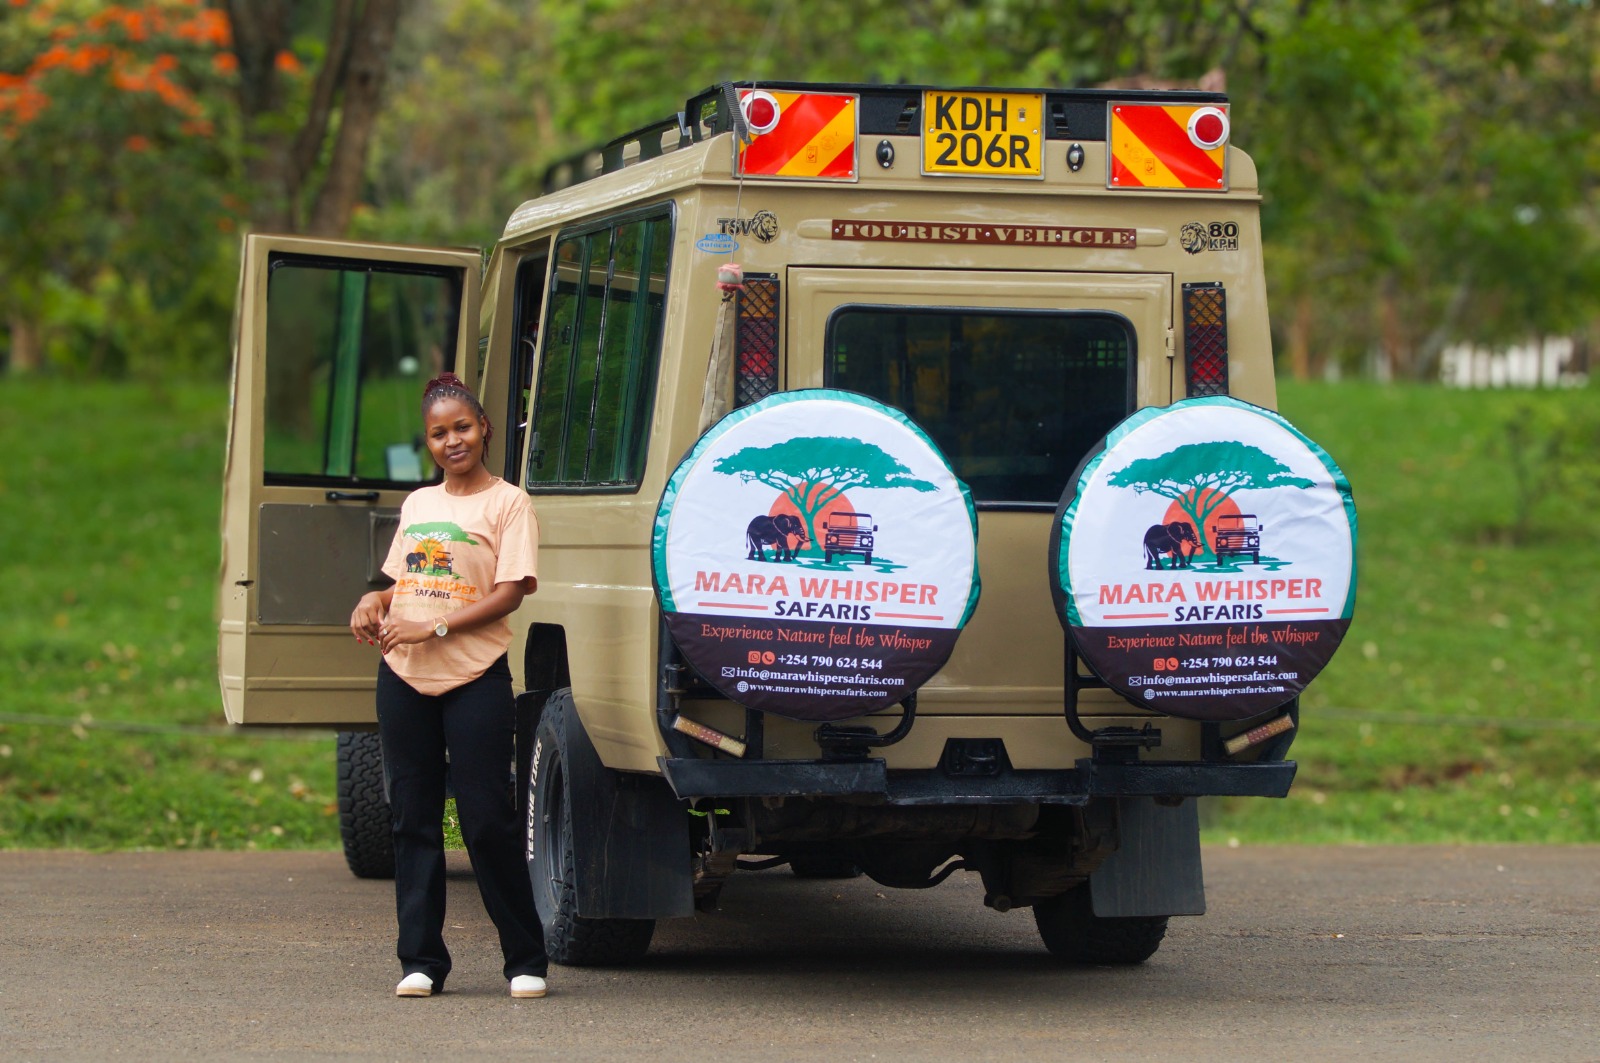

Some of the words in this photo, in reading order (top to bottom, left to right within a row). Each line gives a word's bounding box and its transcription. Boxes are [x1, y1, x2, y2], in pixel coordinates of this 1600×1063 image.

[935, 95, 1008, 132] KDH
[935, 132, 1031, 168] 206R
[718, 218, 753, 236] TSV
[839, 223, 982, 241] TOURIST
[993, 227, 1130, 244] VEHICLE
[1209, 223, 1238, 237] 80
[1209, 238, 1238, 249] KPH
[415, 589, 451, 599] SAFARIS
[423, 579, 477, 595] WHISPER
[694, 571, 790, 597] MARA
[801, 577, 939, 605] WHISPER
[1099, 582, 1187, 605] MARA
[1195, 578, 1323, 601] WHISPER
[774, 600, 871, 620] SAFARIS
[1174, 604, 1263, 622] SAFARIS
[701, 623, 773, 642] Experience
[777, 628, 825, 644] Nature
[828, 626, 853, 648] feel
[855, 628, 875, 648] the
[879, 630, 932, 653] Whisper
[1107, 633, 1175, 653] Experience
[1178, 633, 1223, 646] Nature
[1226, 626, 1248, 649] feel
[1250, 625, 1269, 645] the
[1271, 624, 1320, 646] Whisper
[778, 654, 808, 666] +254
[811, 656, 833, 667] 790
[836, 657, 858, 669] 624
[861, 658, 883, 670] 544
[1180, 657, 1209, 669] +254
[1212, 656, 1232, 668] 790
[1235, 656, 1255, 667] 624
[1257, 655, 1278, 666] 544
[736, 667, 905, 686] info@marawhispersafaris.com
[1142, 670, 1298, 686] info@marawhispersafaris.com
[749, 683, 888, 697] www.marawhispersafaris.com
[1155, 685, 1285, 697] www.marawhispersafaris.com
[531, 737, 543, 788] TIRES
[527, 791, 536, 862] TESCHE
